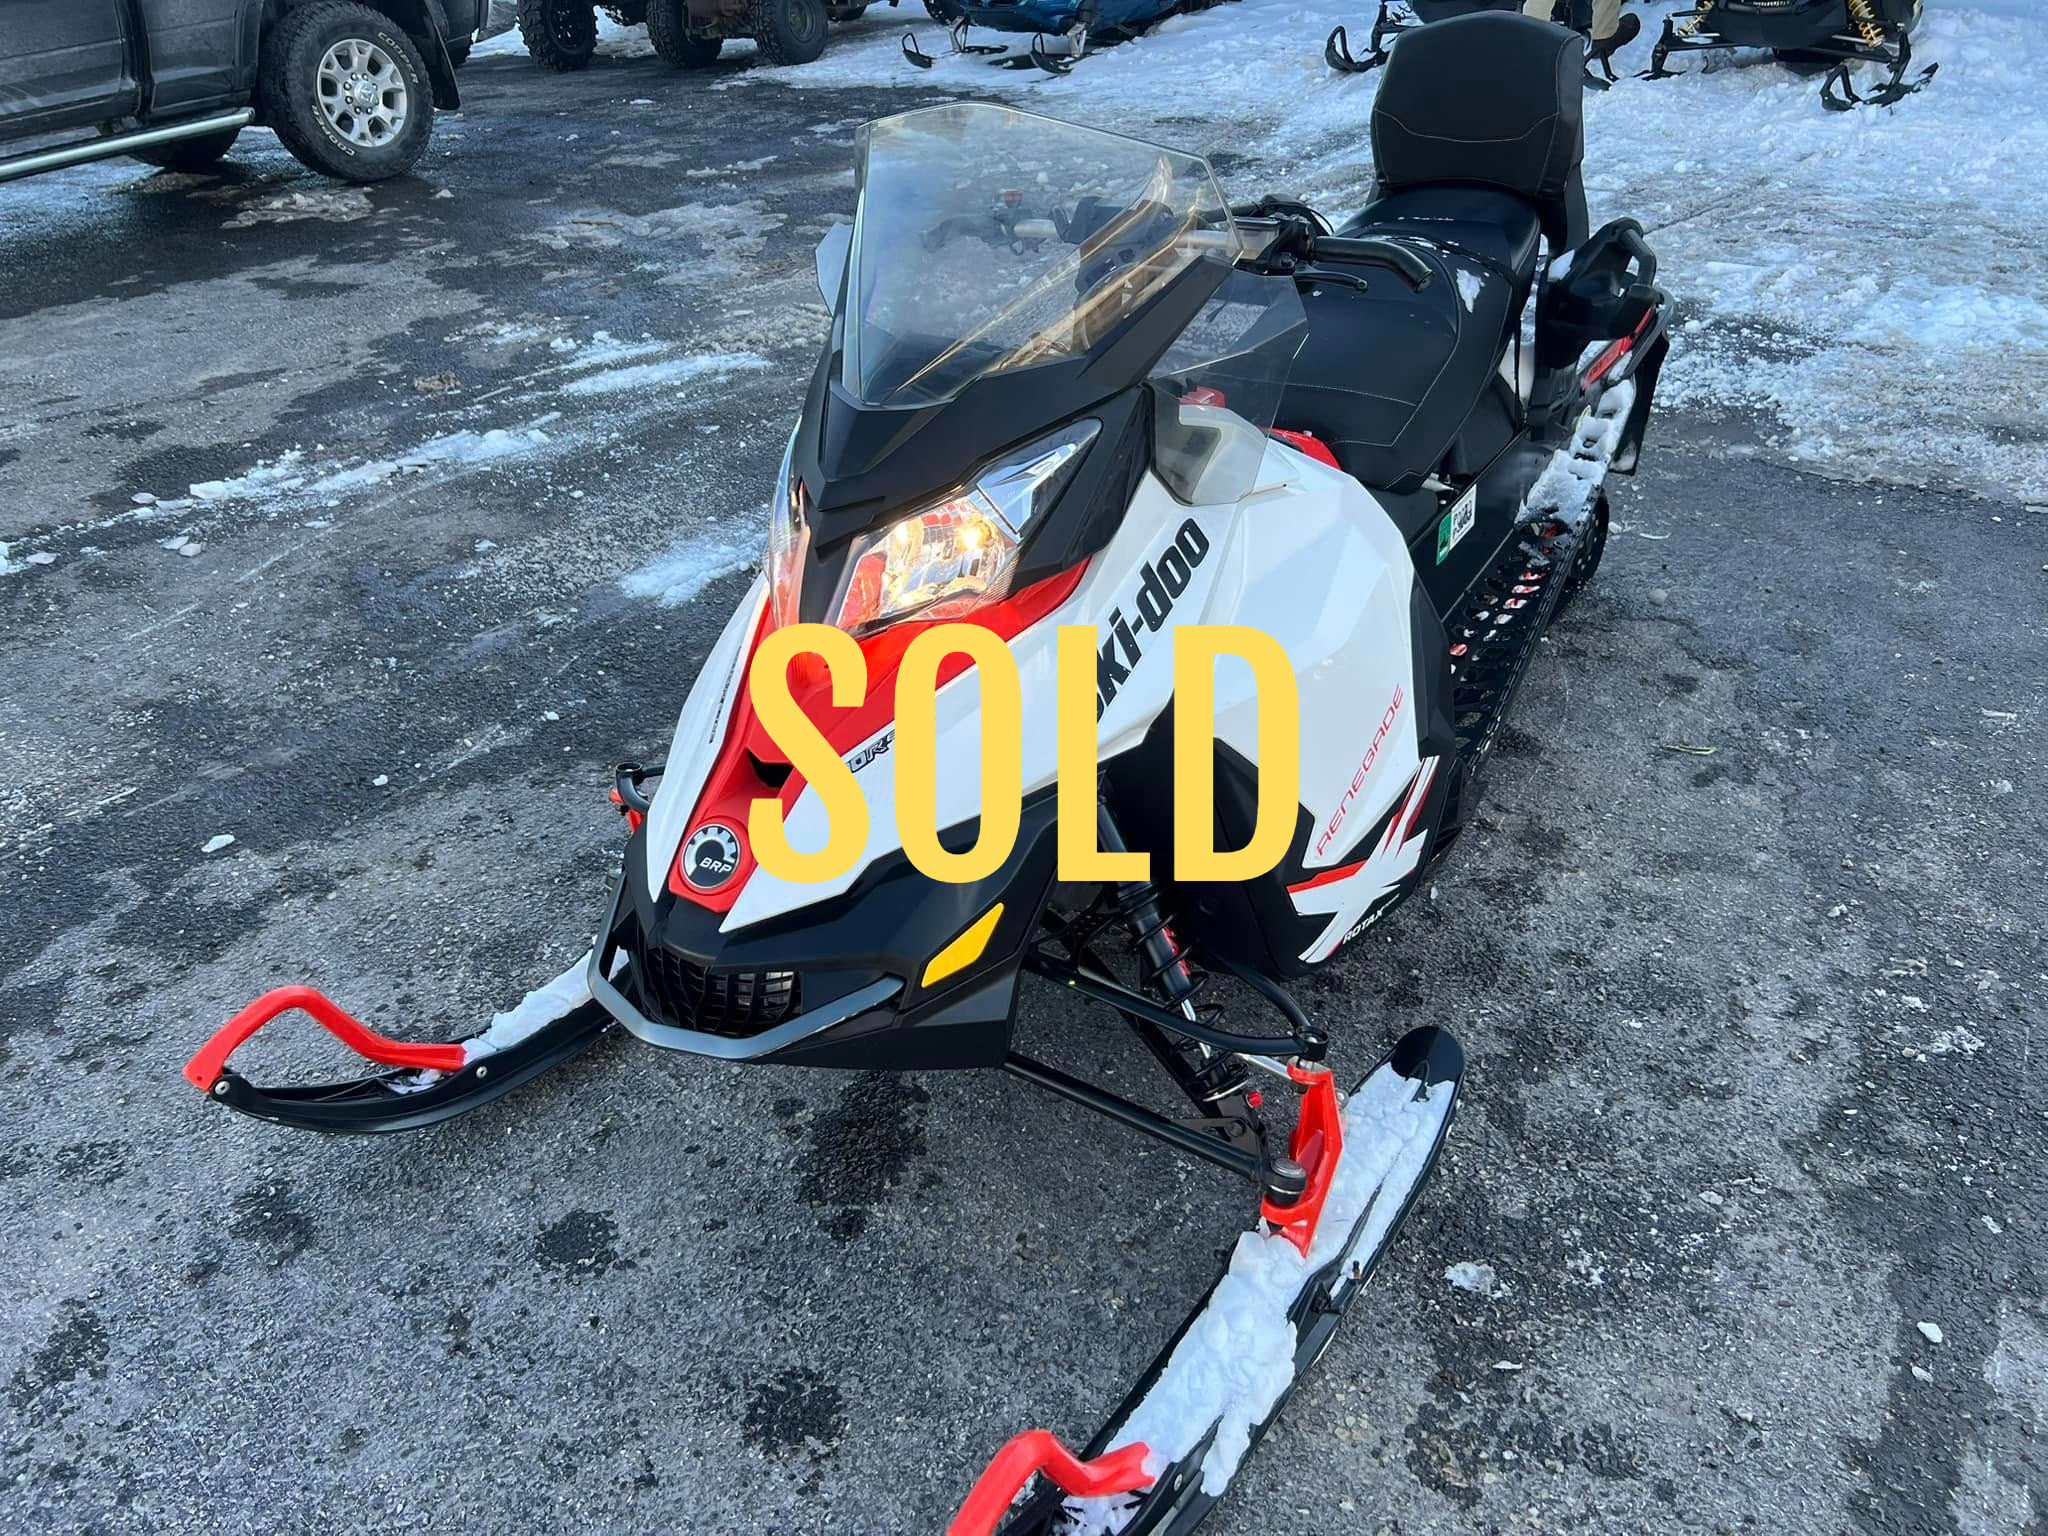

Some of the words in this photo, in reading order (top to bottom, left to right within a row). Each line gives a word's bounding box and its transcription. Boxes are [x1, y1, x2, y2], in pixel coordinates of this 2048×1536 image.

[377, 31, 419, 84] COOPER
[1097, 517, 1210, 724] ki-doo
[1316, 684, 1405, 857] RENEGADE
[699, 856, 732, 873] BRP
